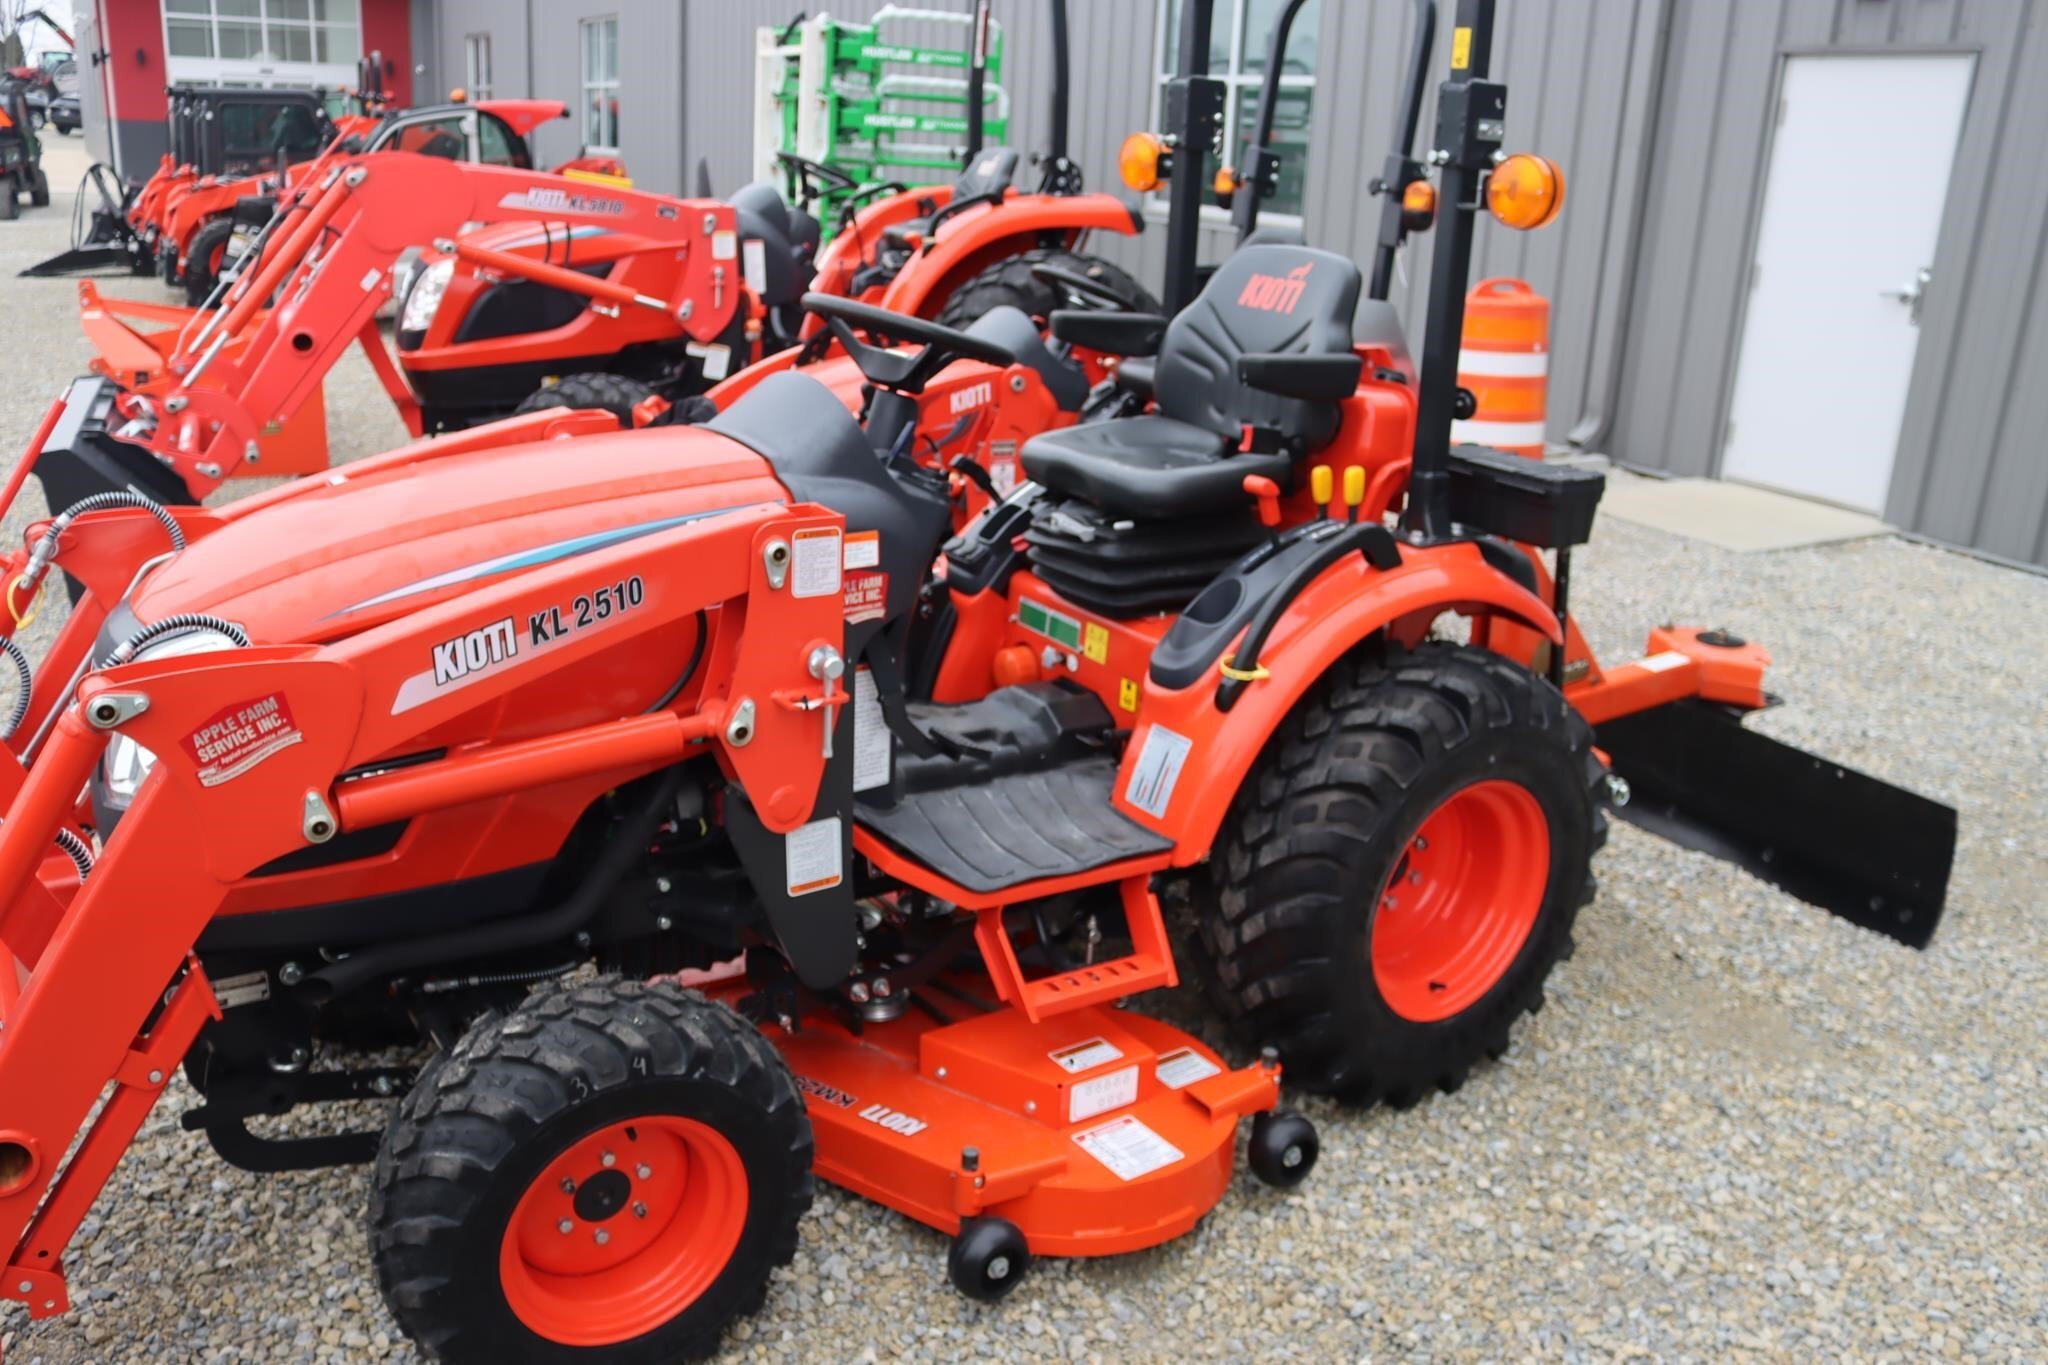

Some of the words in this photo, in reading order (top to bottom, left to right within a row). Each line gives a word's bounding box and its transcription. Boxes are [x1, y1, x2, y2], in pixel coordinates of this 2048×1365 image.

[1237, 271, 1307, 315] KIOTI
[950, 381, 992, 415] KIOTI
[432, 616, 518, 687] KIOTI
[192, 717, 238, 748] APPLE
[237, 696, 278, 726] FARM
[197, 725, 256, 763] SERVICE
[256, 713, 287, 734] INC.
[633, 1057, 647, 1077] 4
[858, 1103, 928, 1136] KIOTI
